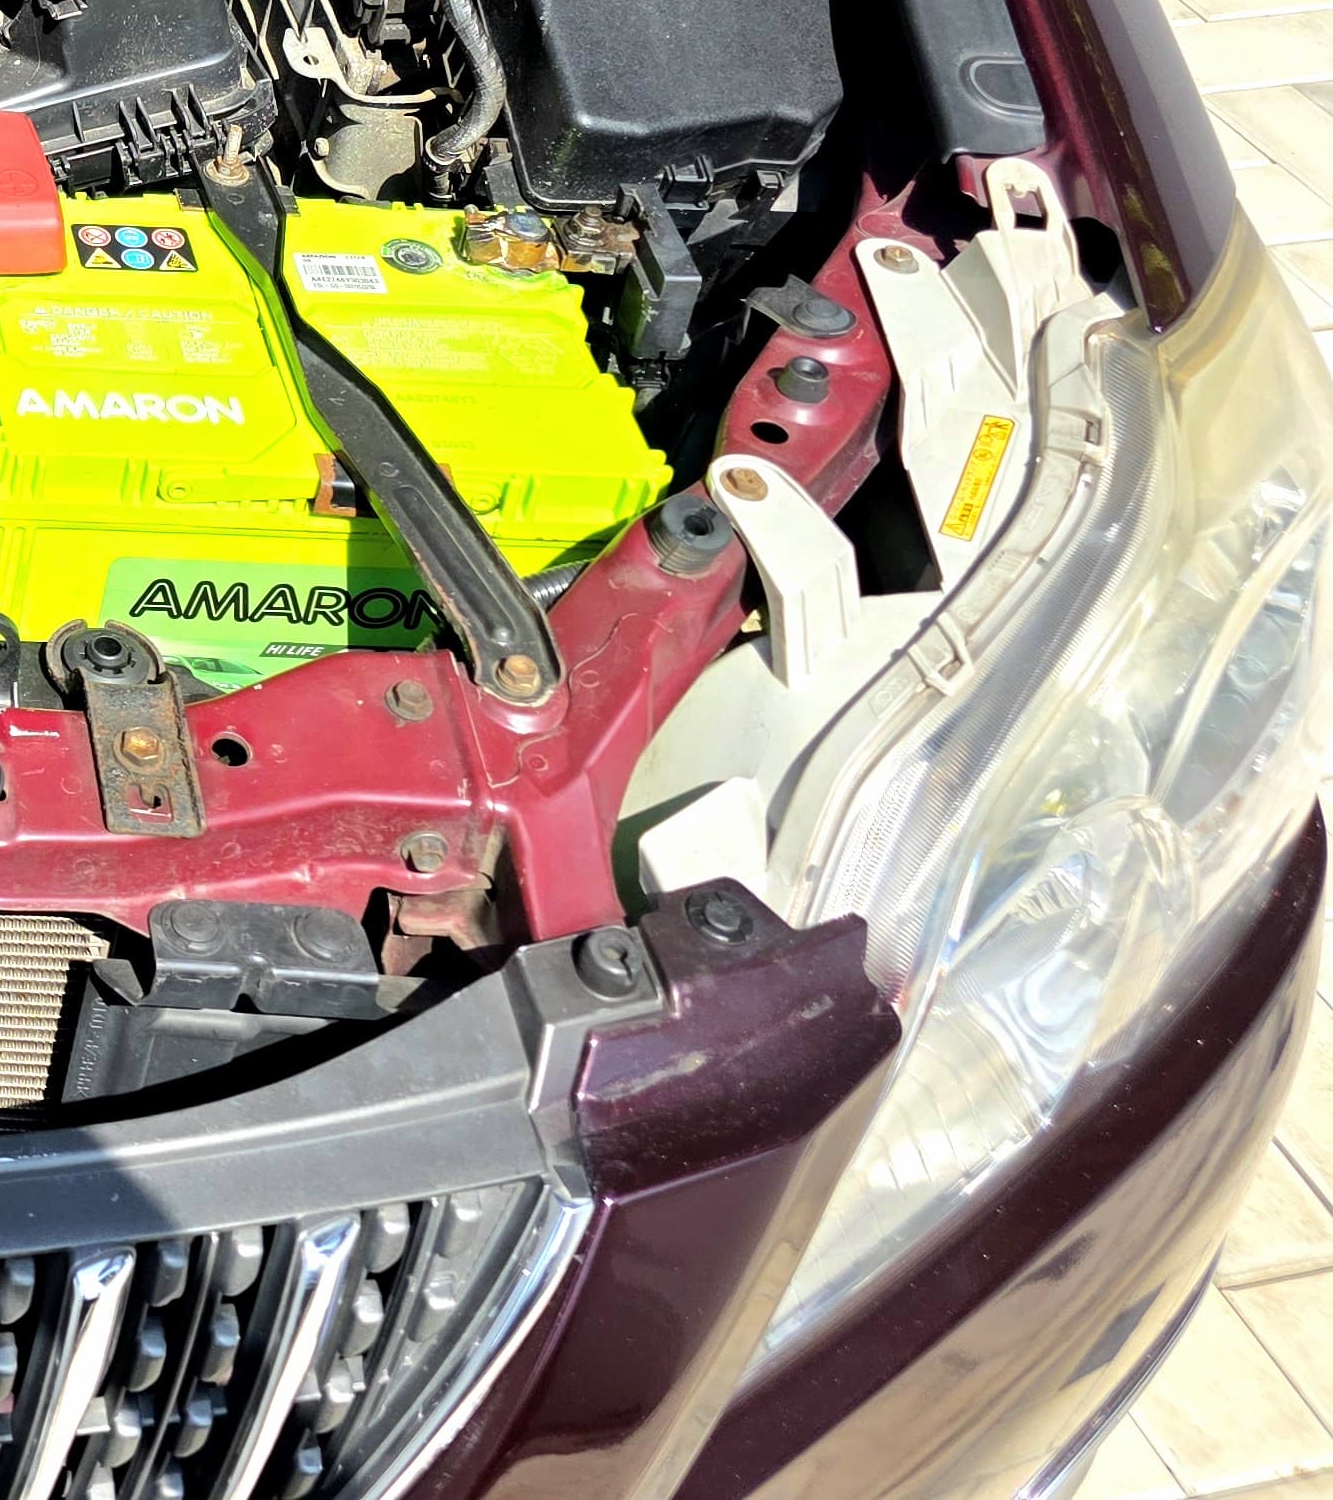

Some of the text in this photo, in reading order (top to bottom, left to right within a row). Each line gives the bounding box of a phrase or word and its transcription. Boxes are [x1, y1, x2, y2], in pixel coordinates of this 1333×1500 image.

[50, 306, 121, 319] DANGER
[136, 308, 213, 322] CAUTION
[15, 387, 245, 425] AMARON
[129, 578, 447, 631] AMARON
[265, 643, 324, 658] HI LIFE
